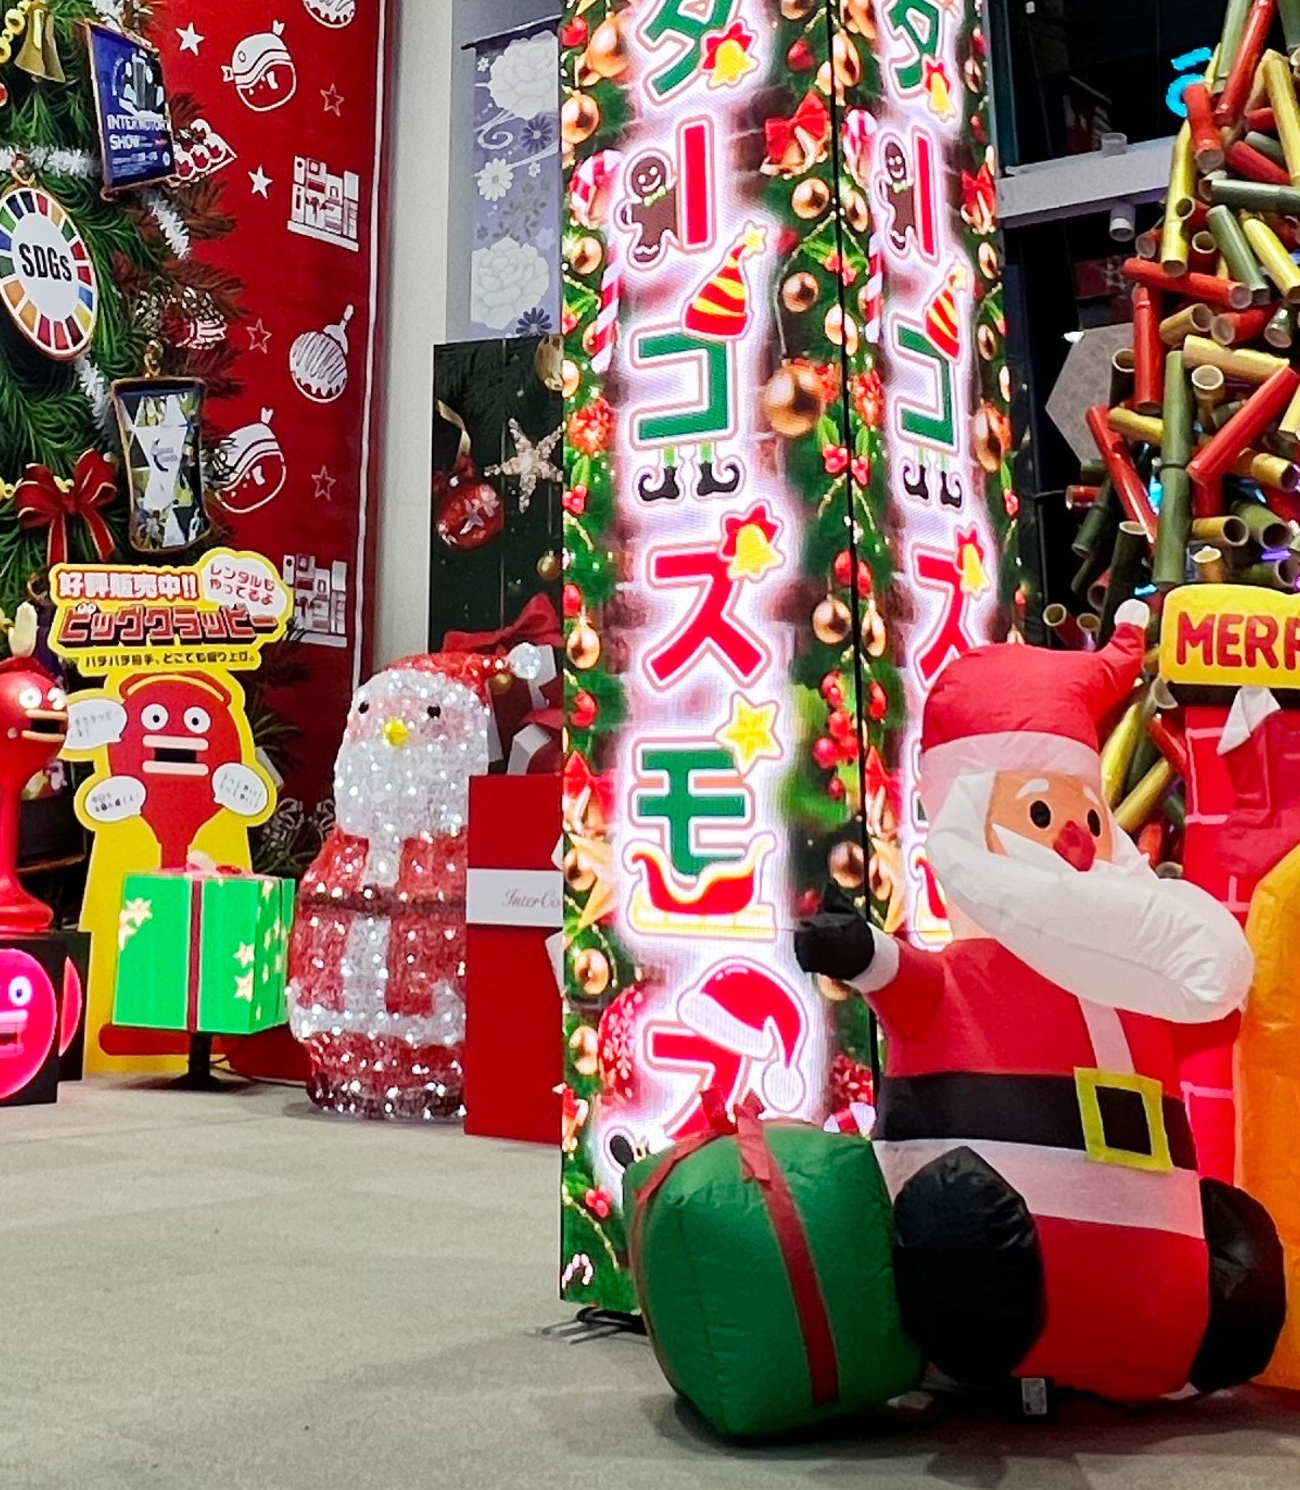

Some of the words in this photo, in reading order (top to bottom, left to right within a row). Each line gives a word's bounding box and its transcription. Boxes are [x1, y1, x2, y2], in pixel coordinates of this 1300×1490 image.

[18, 242, 73, 283] SDGs
[210, 563, 276, 590] レンタルも
